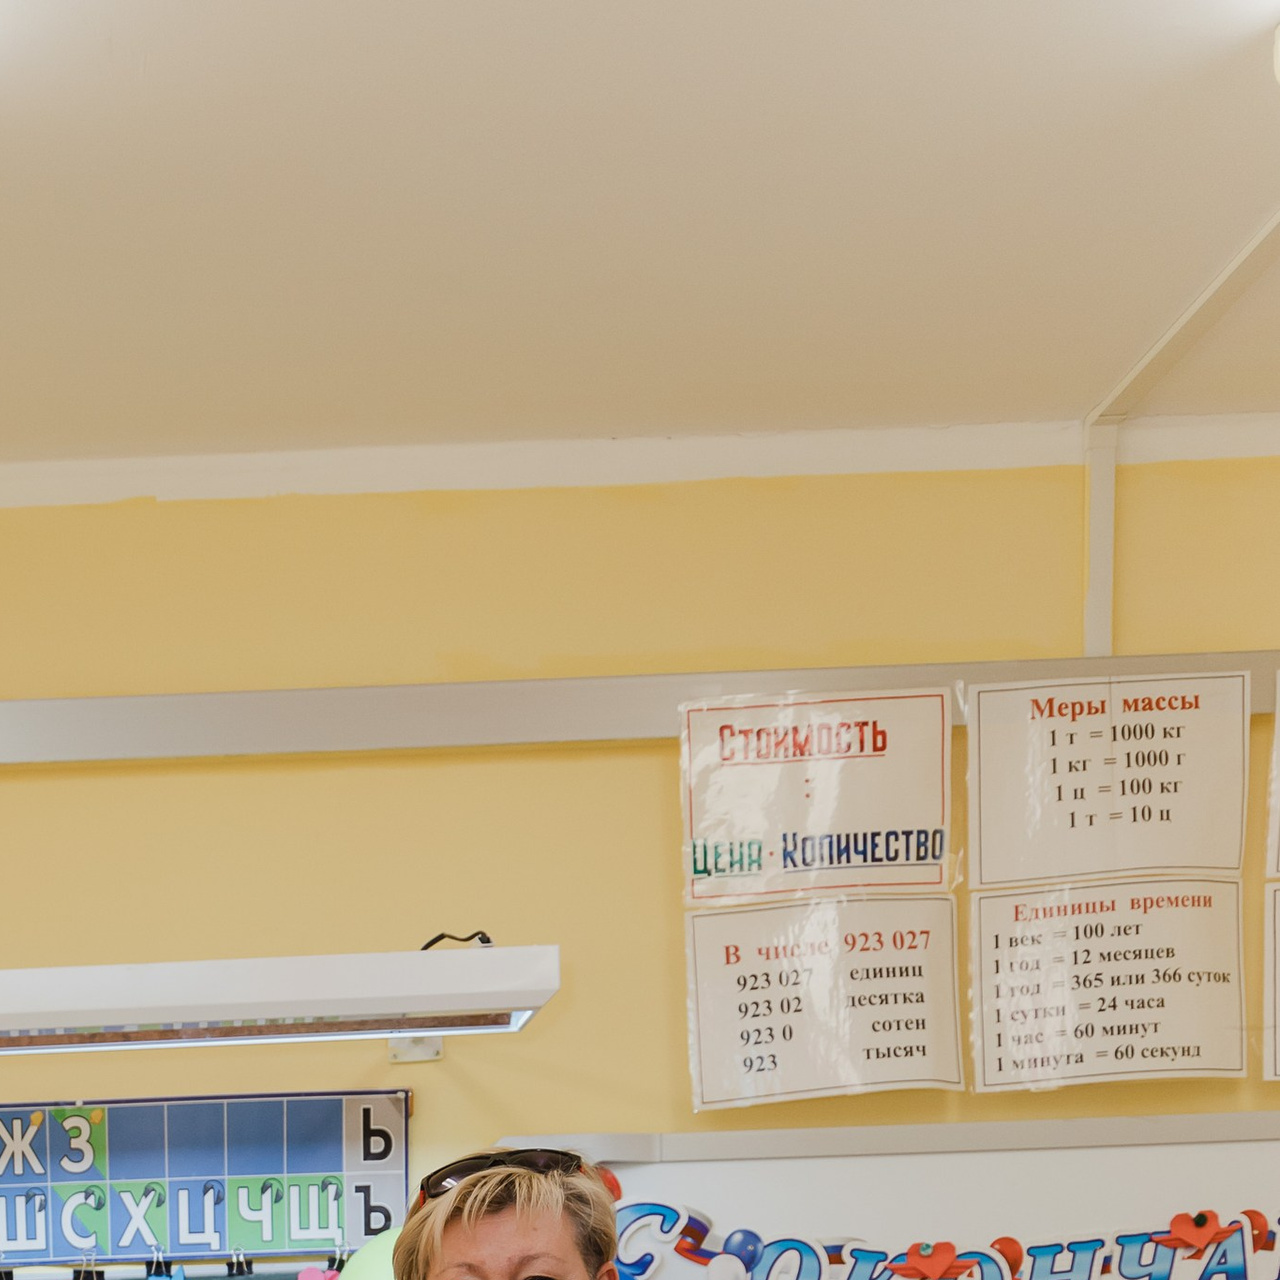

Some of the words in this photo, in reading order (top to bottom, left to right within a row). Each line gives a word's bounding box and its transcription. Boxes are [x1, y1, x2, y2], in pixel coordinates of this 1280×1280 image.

[1030, 697, 1106, 721] Меры
[1123, 694, 1200, 712] массы
[1049, 729, 1057, 747] 1
[1111, 723, 1155, 743] 1000
[1162, 725, 1186, 739] кг
[1051, 757, 1058, 775] 1
[1068, 759, 1092, 773] кг
[1125, 749, 1169, 768] 1000
[1176, 753, 1186, 766] г
[1056, 784, 1063, 802] 1
[1120, 777, 1152, 796] 100
[1160, 780, 1183, 794] кг
[1069, 811, 1076, 828] 1
[1131, 805, 1152, 823] 10
[1013, 899, 1116, 923] Единицы
[1130, 894, 1213, 914] времени
[725, 945, 741, 965] В
[844, 932, 884, 952] 923
[893, 930, 931, 950] 027
[993, 933, 1000, 949] 1
[1009, 933, 1042, 948] век
[1074, 923, 1105, 941] 100
[1110, 922, 1143, 937] лет
[1072, 949, 1092, 966] 12
[1099, 946, 1176, 965] месяцев
[737, 972, 771, 992] 923
[850, 965, 923, 981] единиц
[1071, 973, 1104, 991] 365
[1111, 972, 1145, 987] или
[1151, 967, 1182, 984] 366
[1187, 968, 1231, 987] суток
[738, 1000, 773, 1020] 923
[780, 996, 803, 1015] 02
[847, 991, 925, 1009] десятка
[1010, 1005, 1066, 1026] сутки
[1097, 996, 1118, 1013] 24
[1124, 996, 1165, 1011] часа
[740, 1027, 775, 1047] 923
[872, 1017, 926, 1033] сотен
[1012, 1031, 1044, 1046] час
[1074, 1022, 1095, 1040] 60
[1101, 1021, 1161, 1039] минут
[743, 1054, 778, 1074] 923
[863, 1045, 927, 1060] тысяч
[1012, 1052, 1084, 1072] минута
[1114, 1044, 1135, 1061] 60
[1141, 1045, 1201, 1062] секунд
[616, 1202, 681, 1277] С
